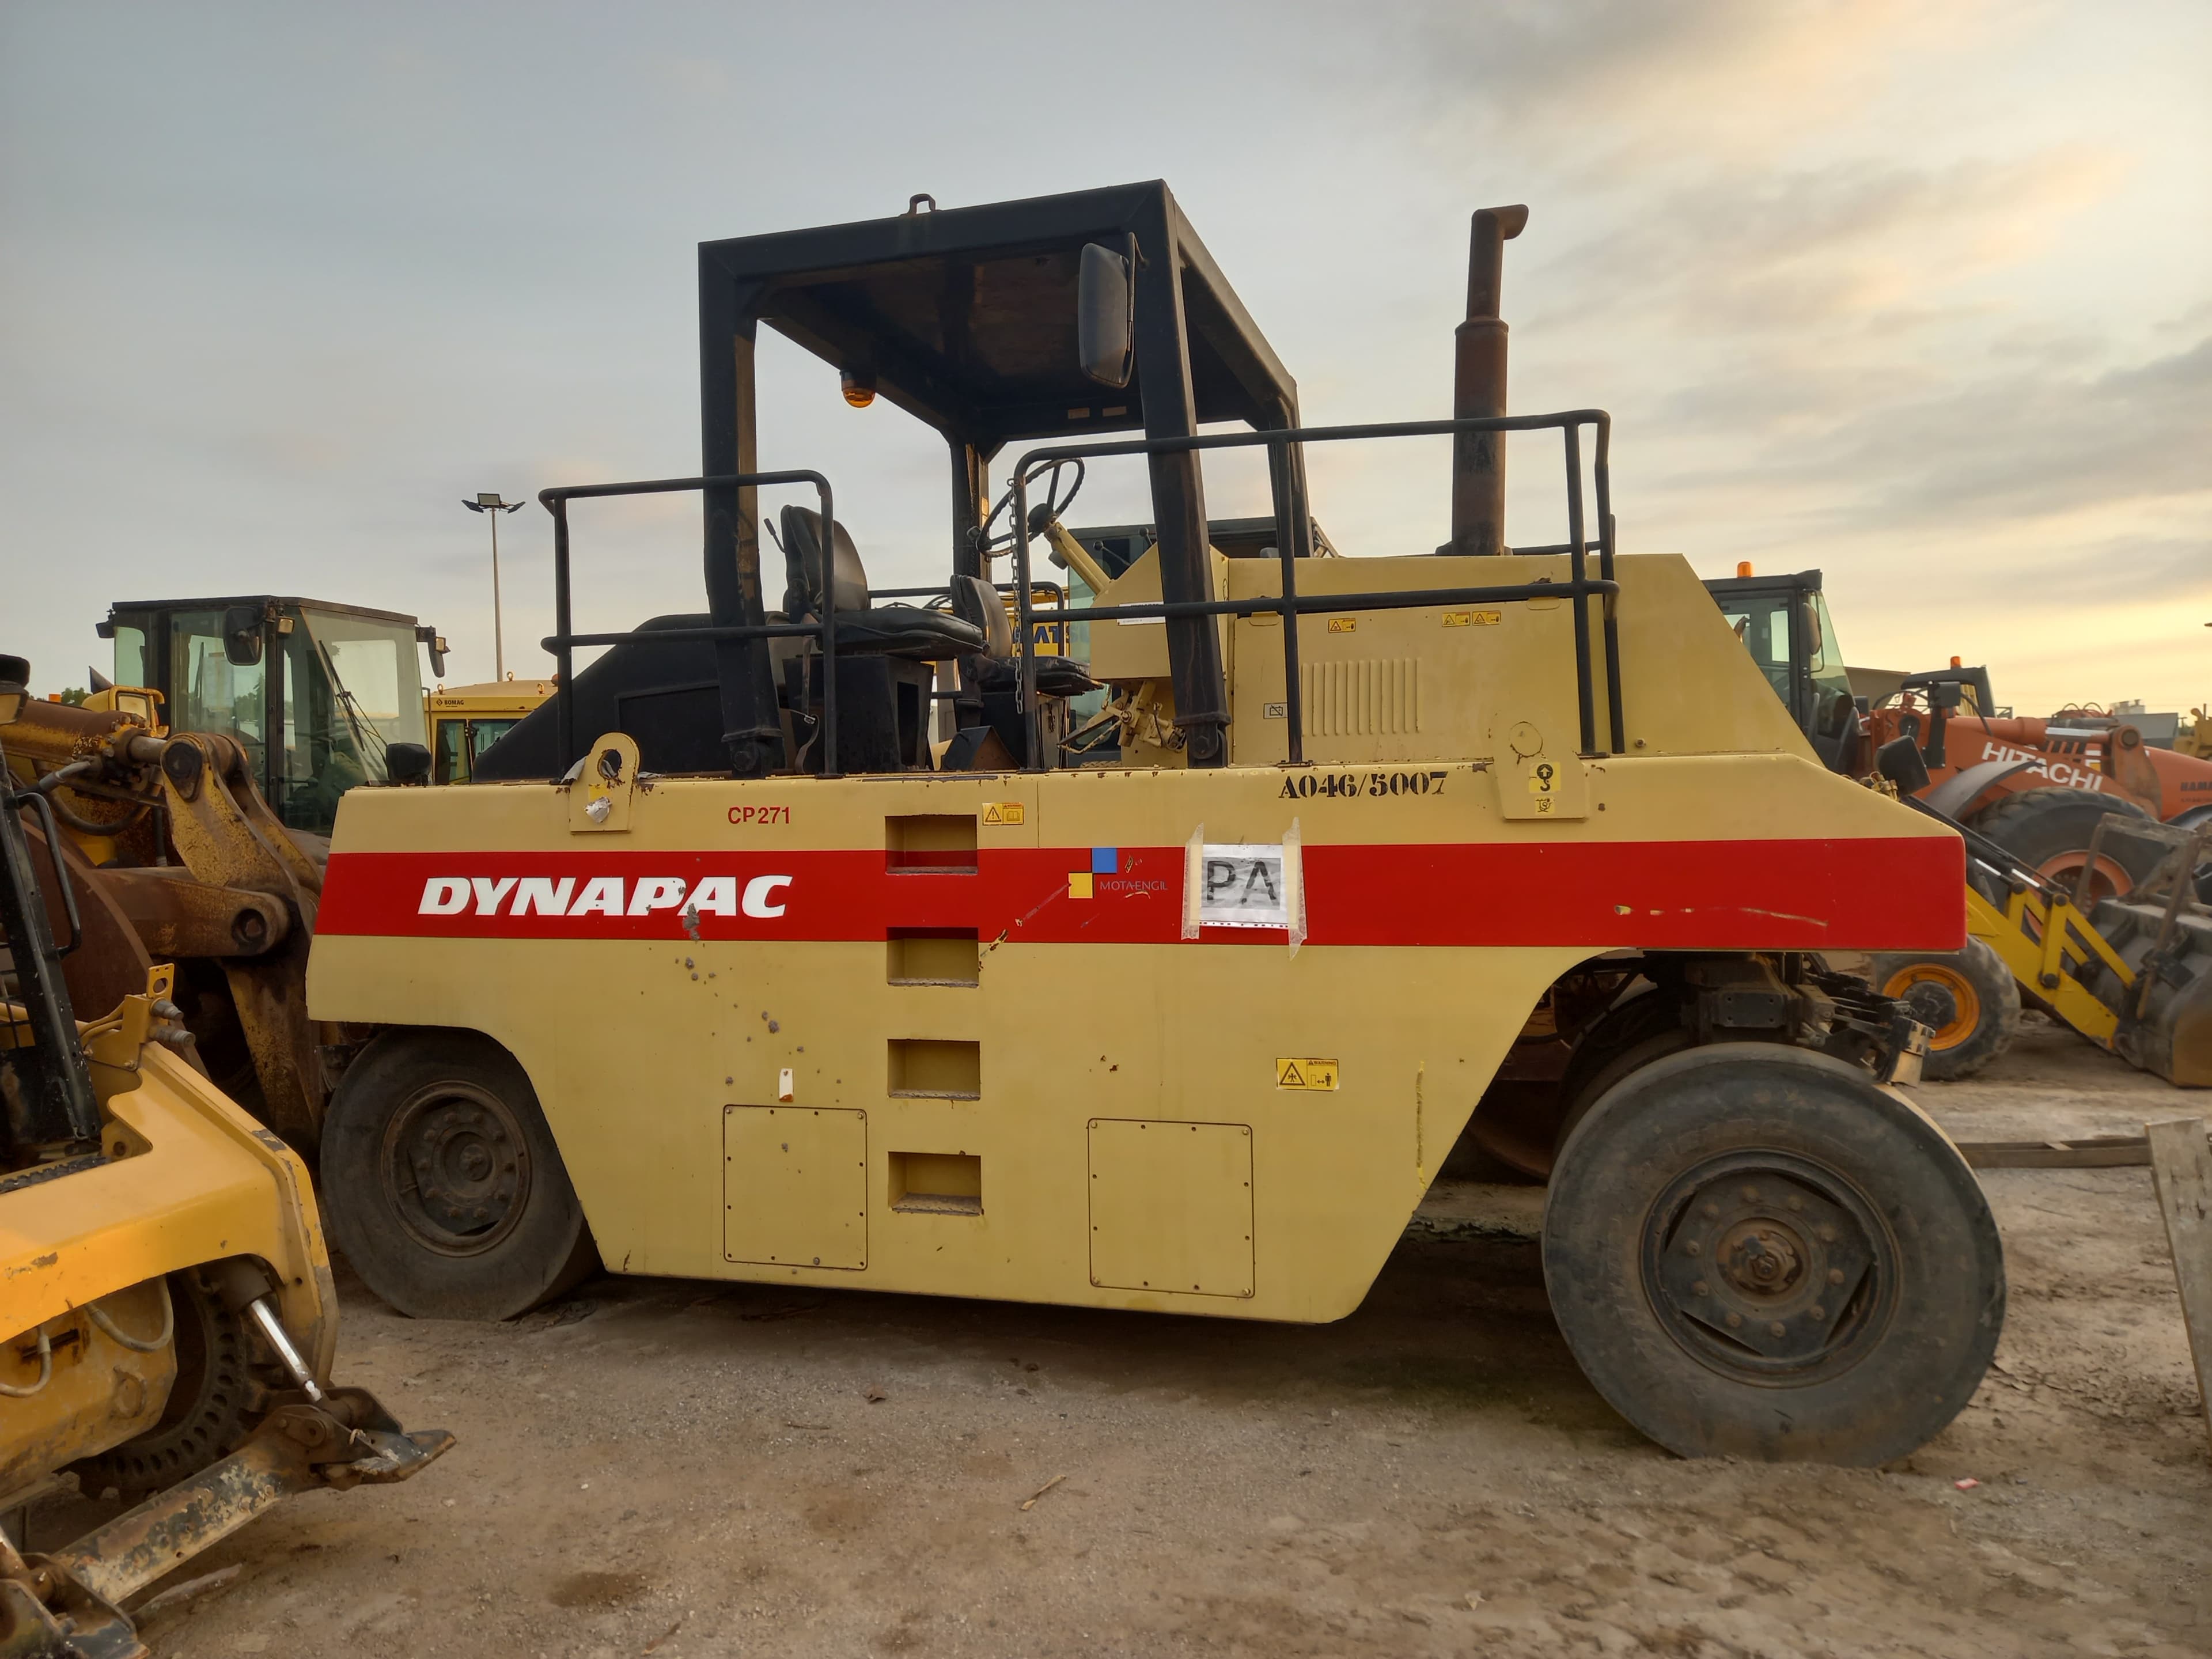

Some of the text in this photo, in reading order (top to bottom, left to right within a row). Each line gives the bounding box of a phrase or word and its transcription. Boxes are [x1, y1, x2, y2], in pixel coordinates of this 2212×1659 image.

[1982, 741, 2104, 791] HITACHI
[1278, 771, 1448, 799] A046/5007
[728, 806, 789, 824] CP271
[417, 875, 793, 919] DYNAPAC
[1100, 880, 1168, 891] MOTA-ENGIL
[1207, 861, 1277, 905] PA
